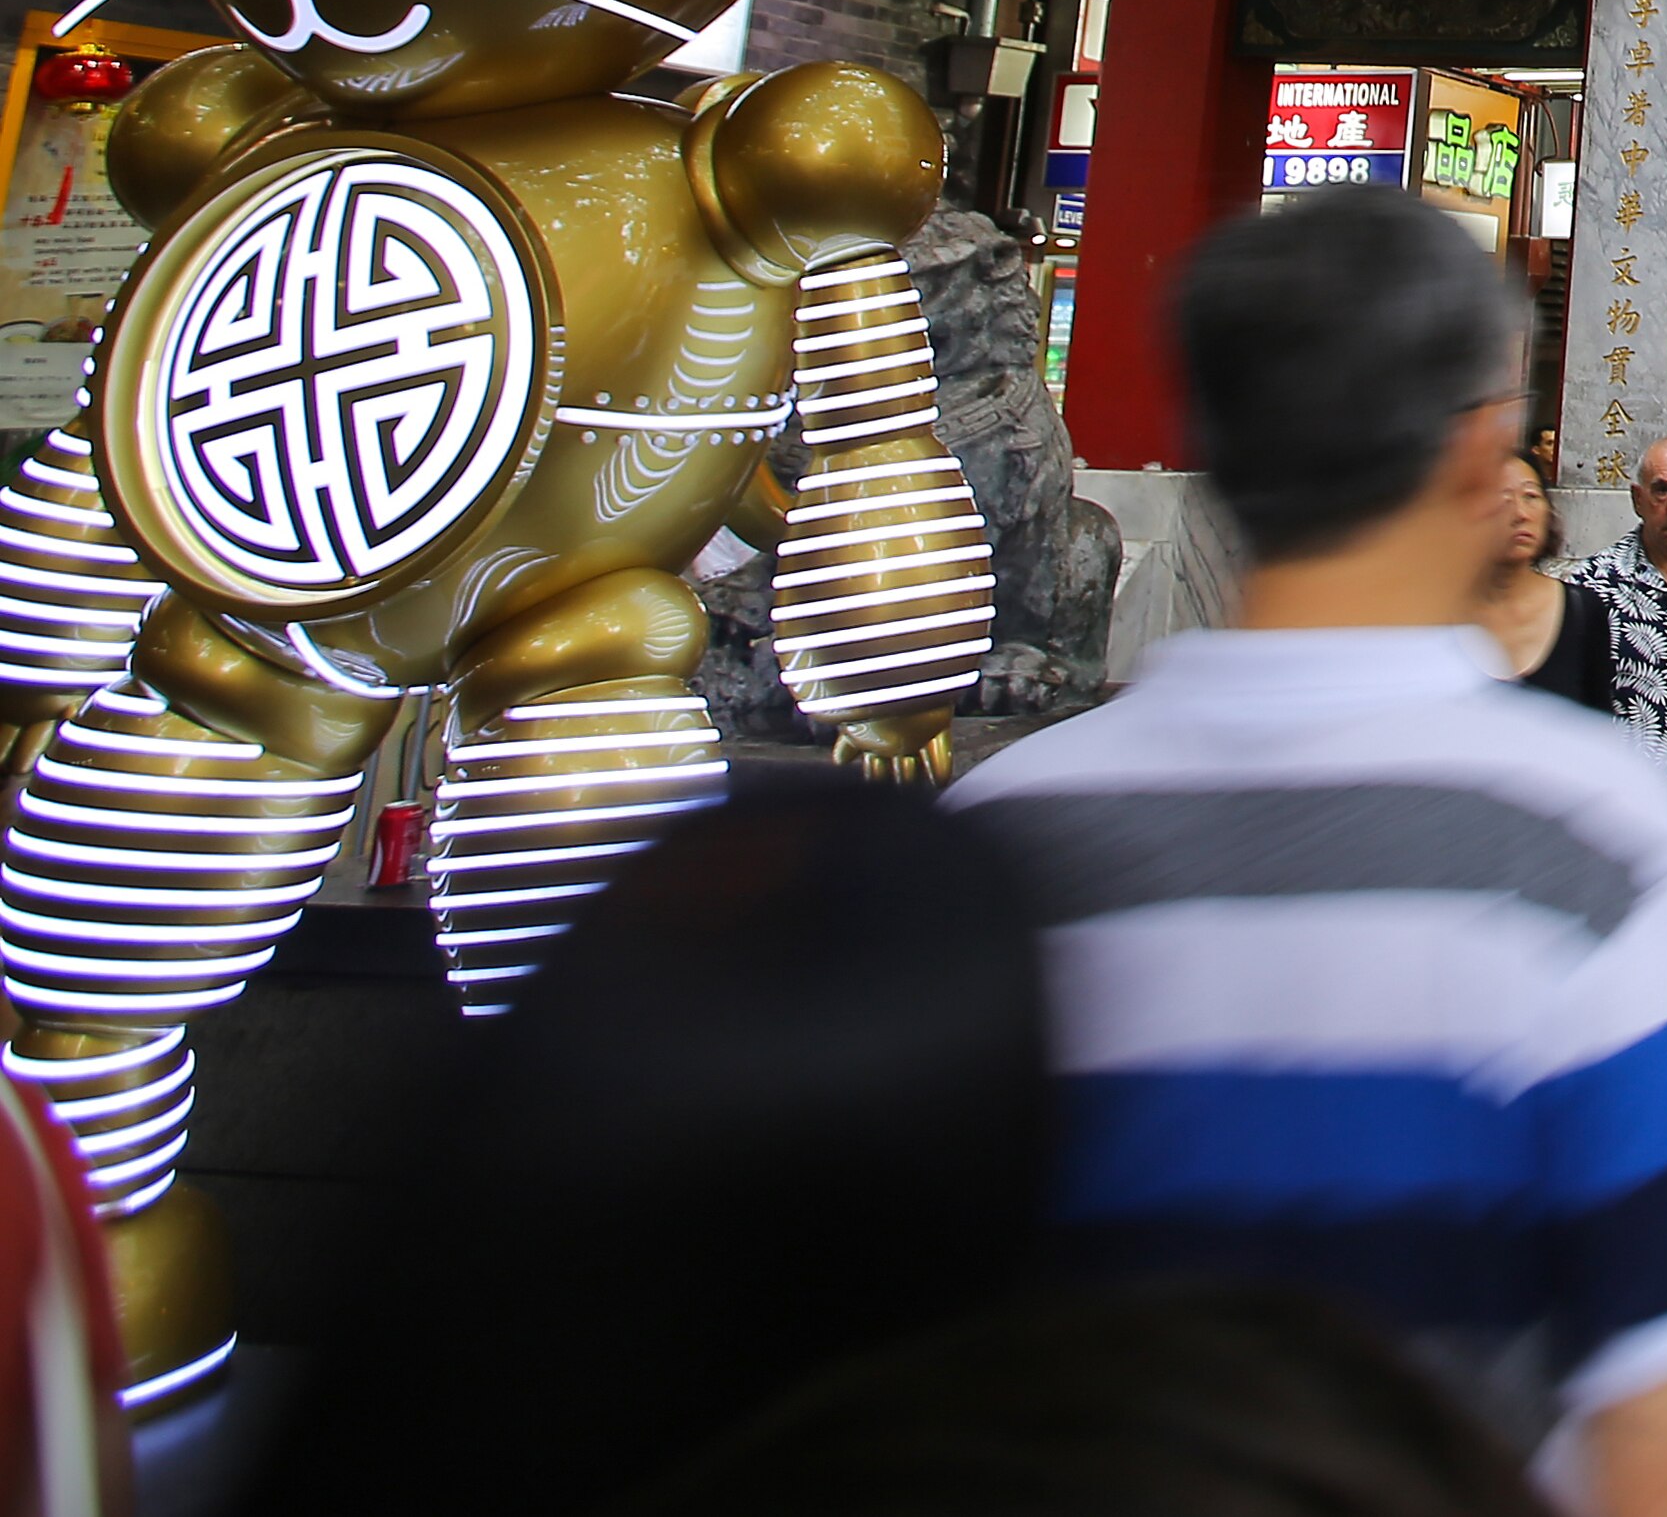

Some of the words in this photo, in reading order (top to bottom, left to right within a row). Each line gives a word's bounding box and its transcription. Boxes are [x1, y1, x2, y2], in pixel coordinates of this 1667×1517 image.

[1277, 82, 1400, 108] INTERNATIONAL
[1265, 109, 1374, 149] 地產
[1284, 156, 1370, 186] 9898
